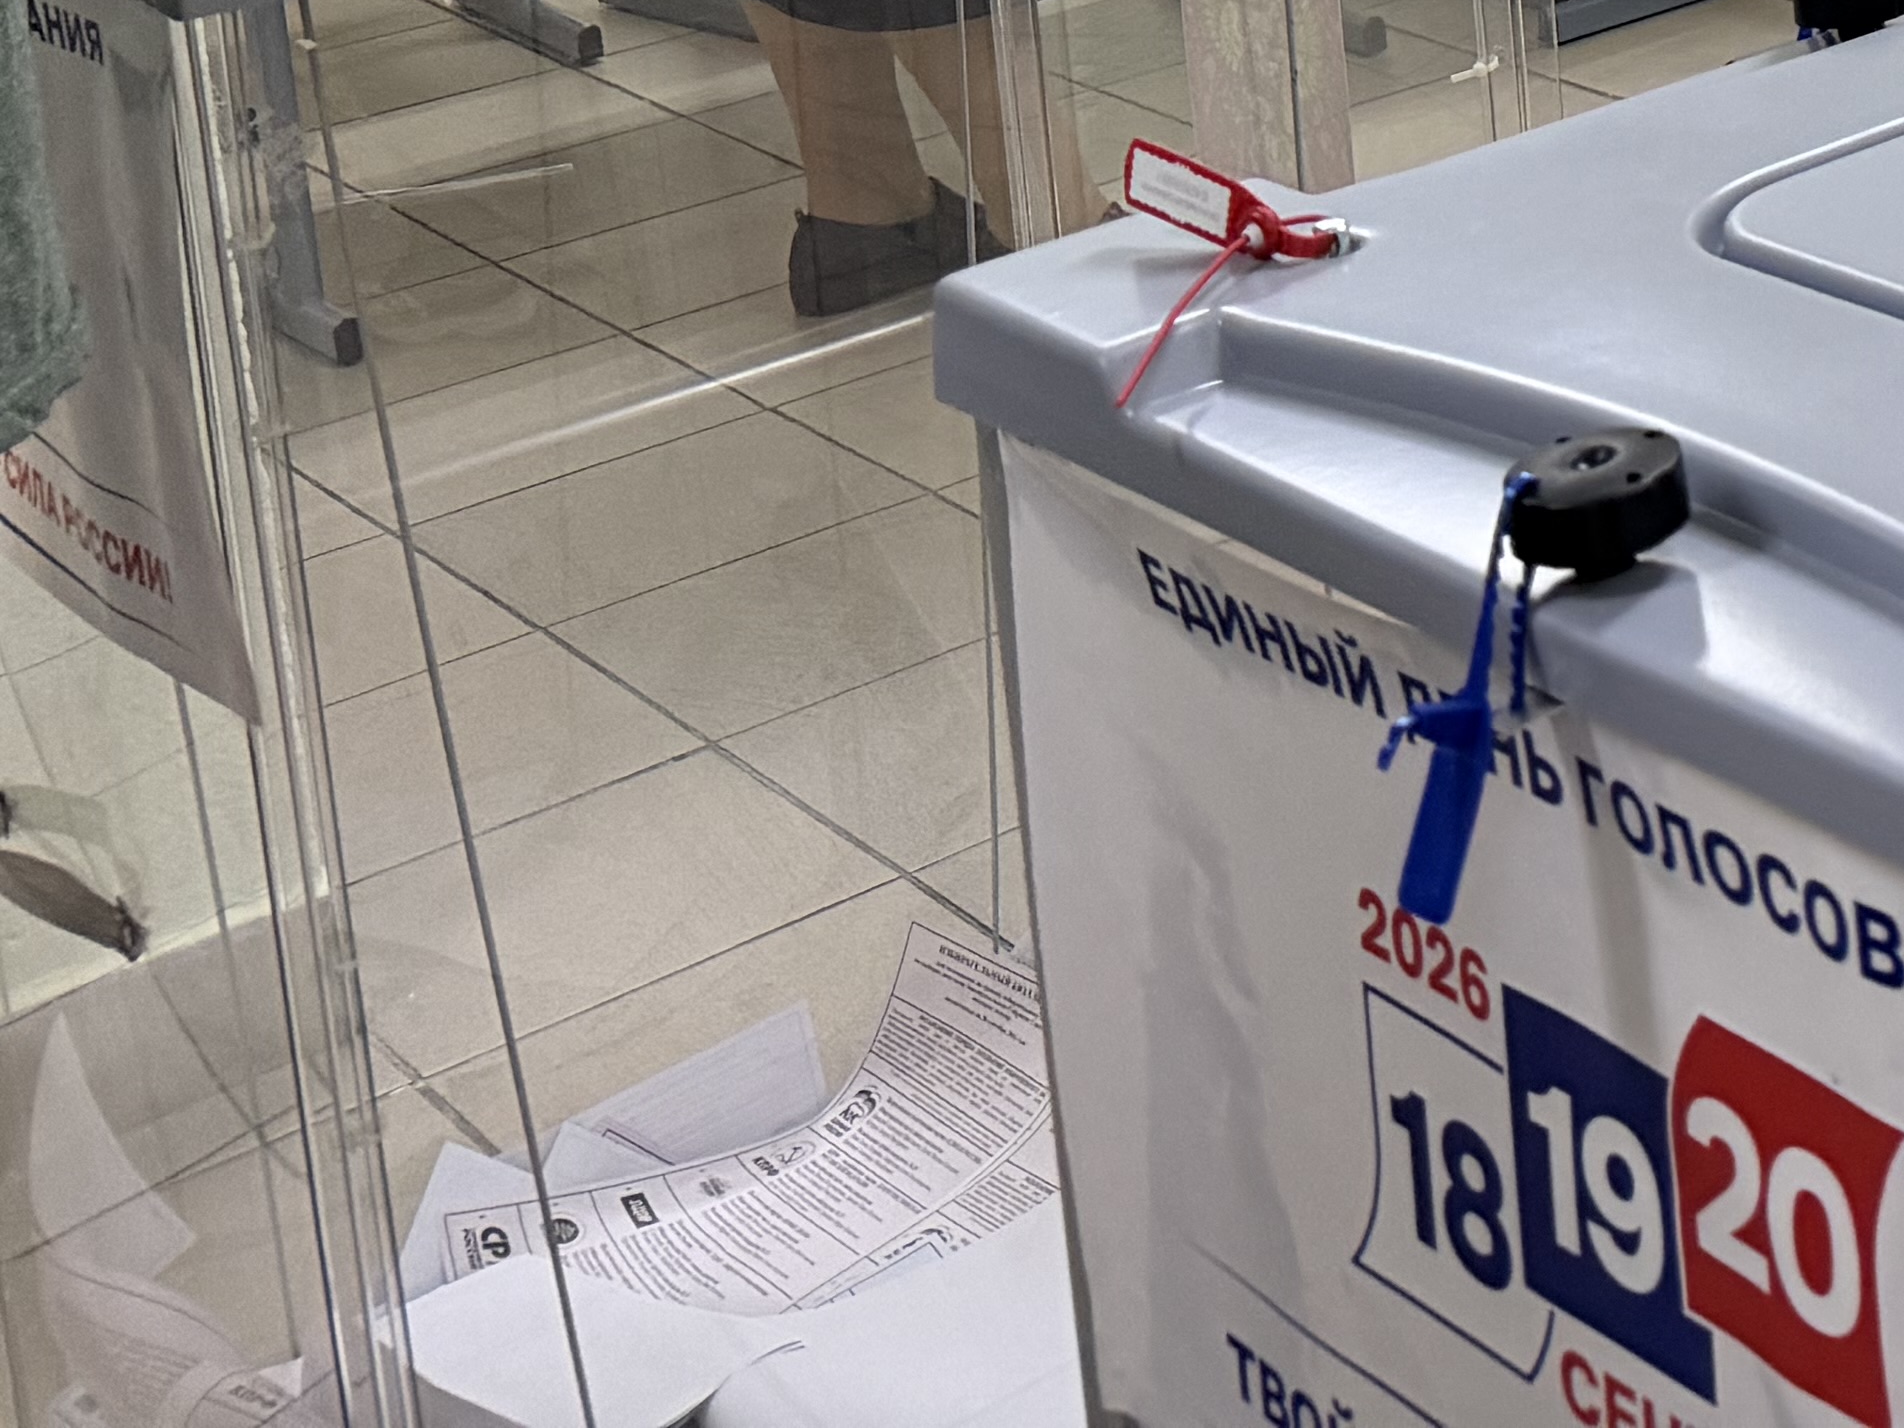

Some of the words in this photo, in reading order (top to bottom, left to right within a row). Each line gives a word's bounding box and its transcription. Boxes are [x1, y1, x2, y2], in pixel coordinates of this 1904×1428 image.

[1137, 547, 1387, 719] ЕДИНЫЙ
[1357, 886, 1491, 1023] 2026
[1391, 1090, 1513, 1292] 18
[1527, 1080, 1666, 1295] 19
[1687, 1096, 1859, 1339] 20
